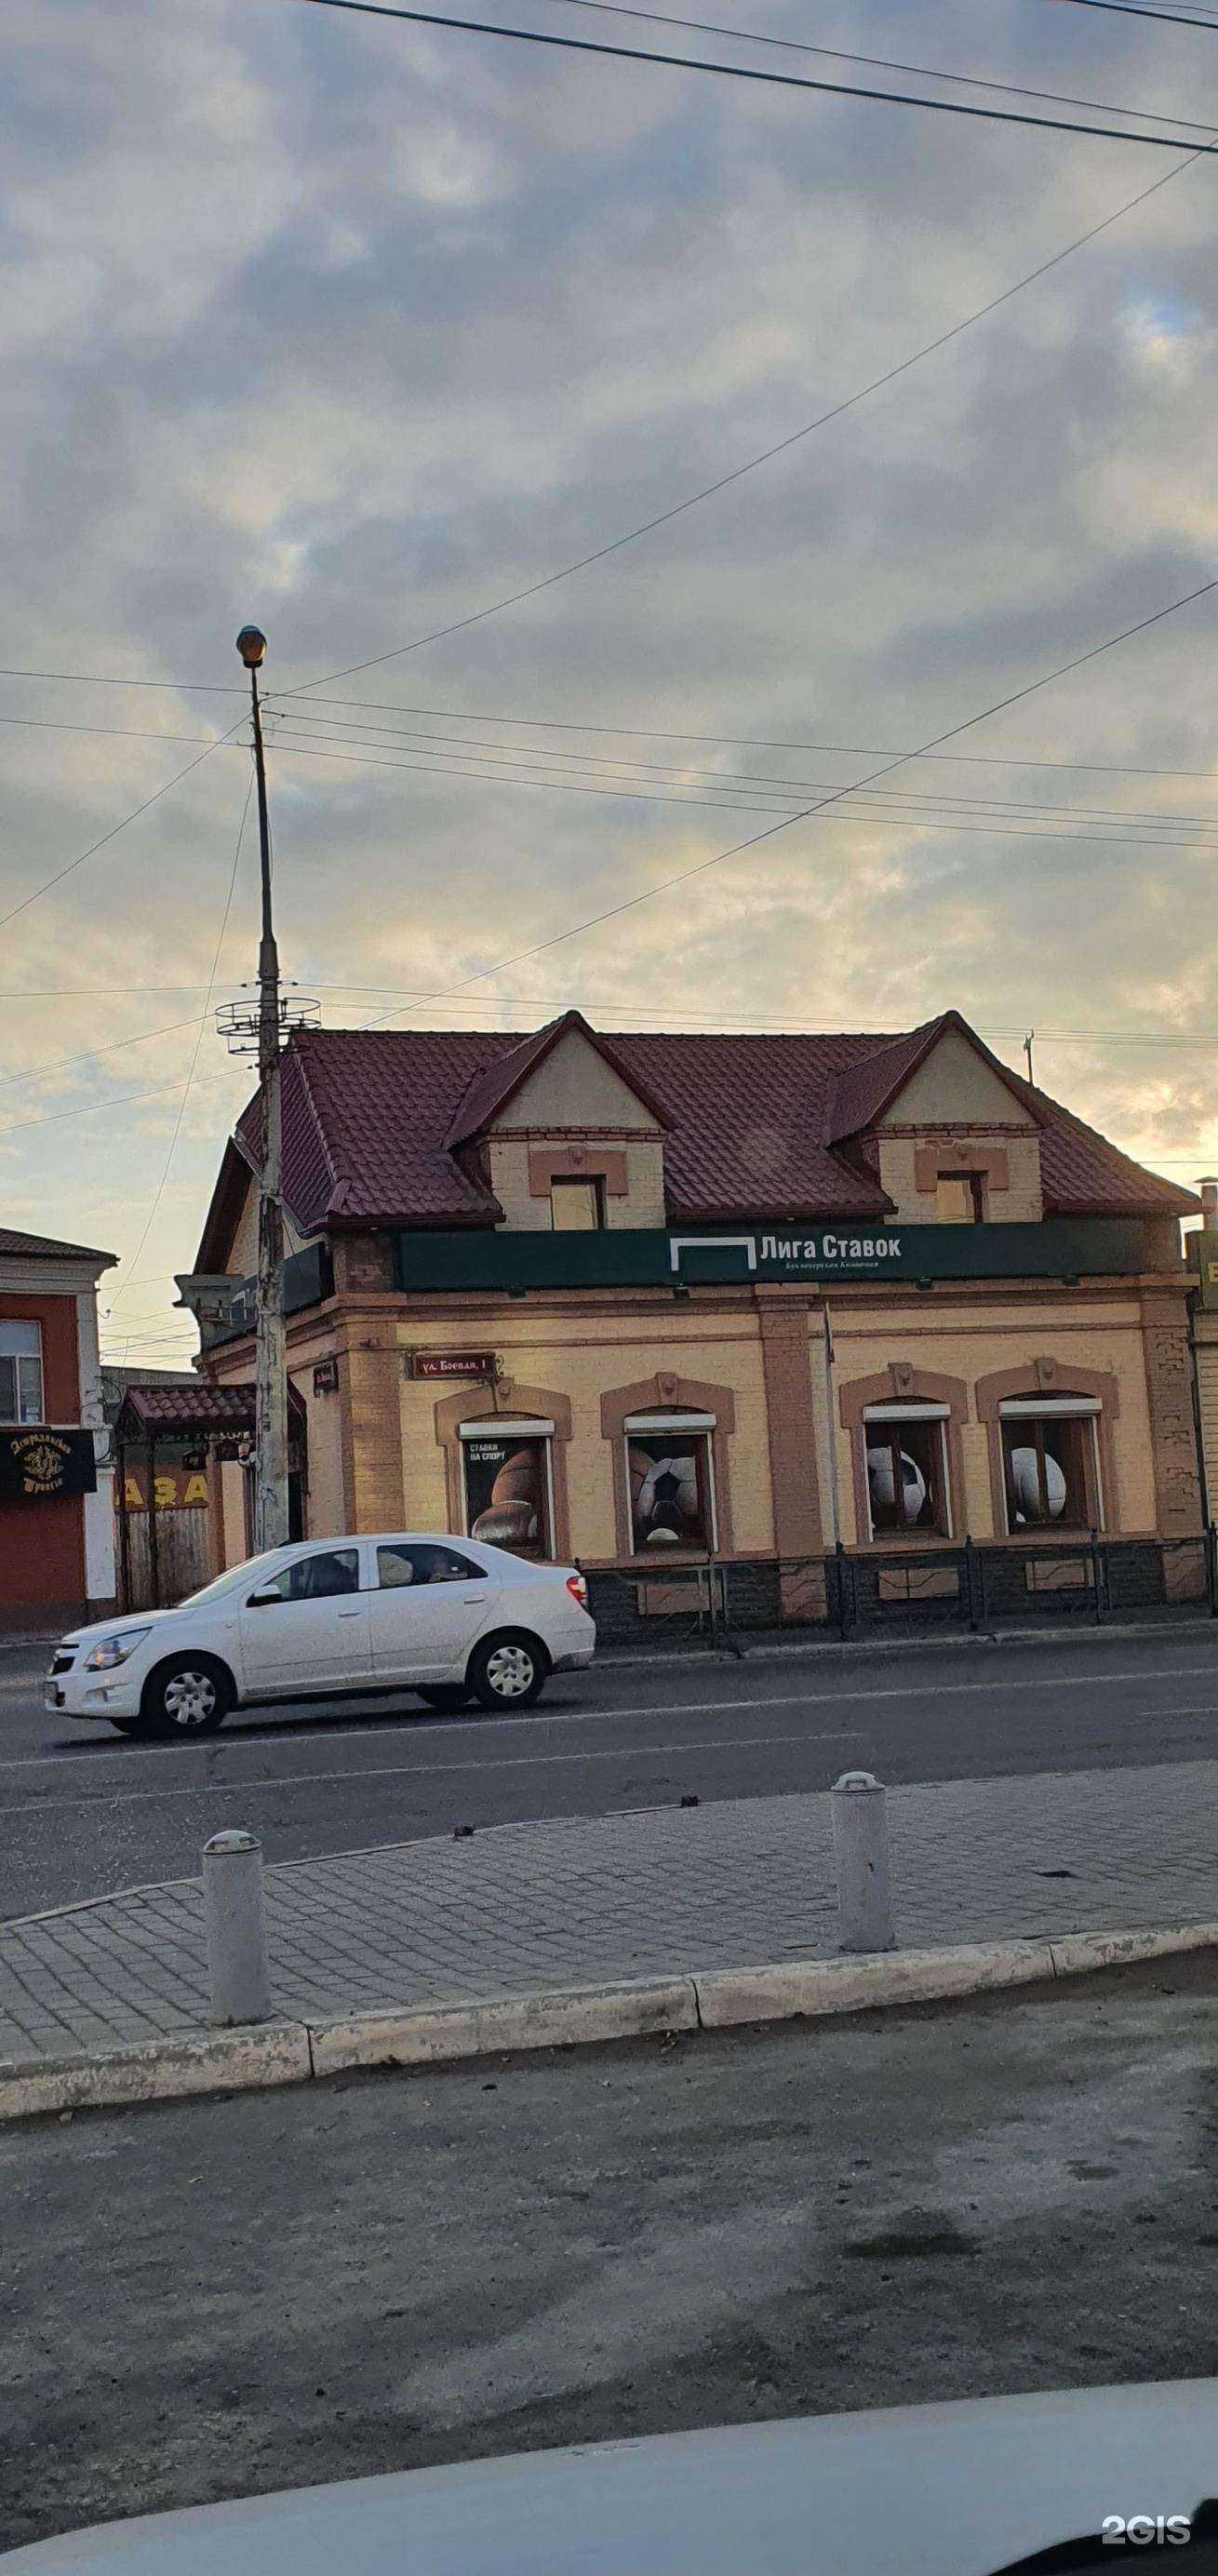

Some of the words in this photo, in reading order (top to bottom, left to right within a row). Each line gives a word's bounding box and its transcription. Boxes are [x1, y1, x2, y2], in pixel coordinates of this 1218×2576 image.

[760, 1236, 816, 1259] Лига
[823, 1234, 902, 1258] Ставок
[422, 1362, 437, 1374] ул.
